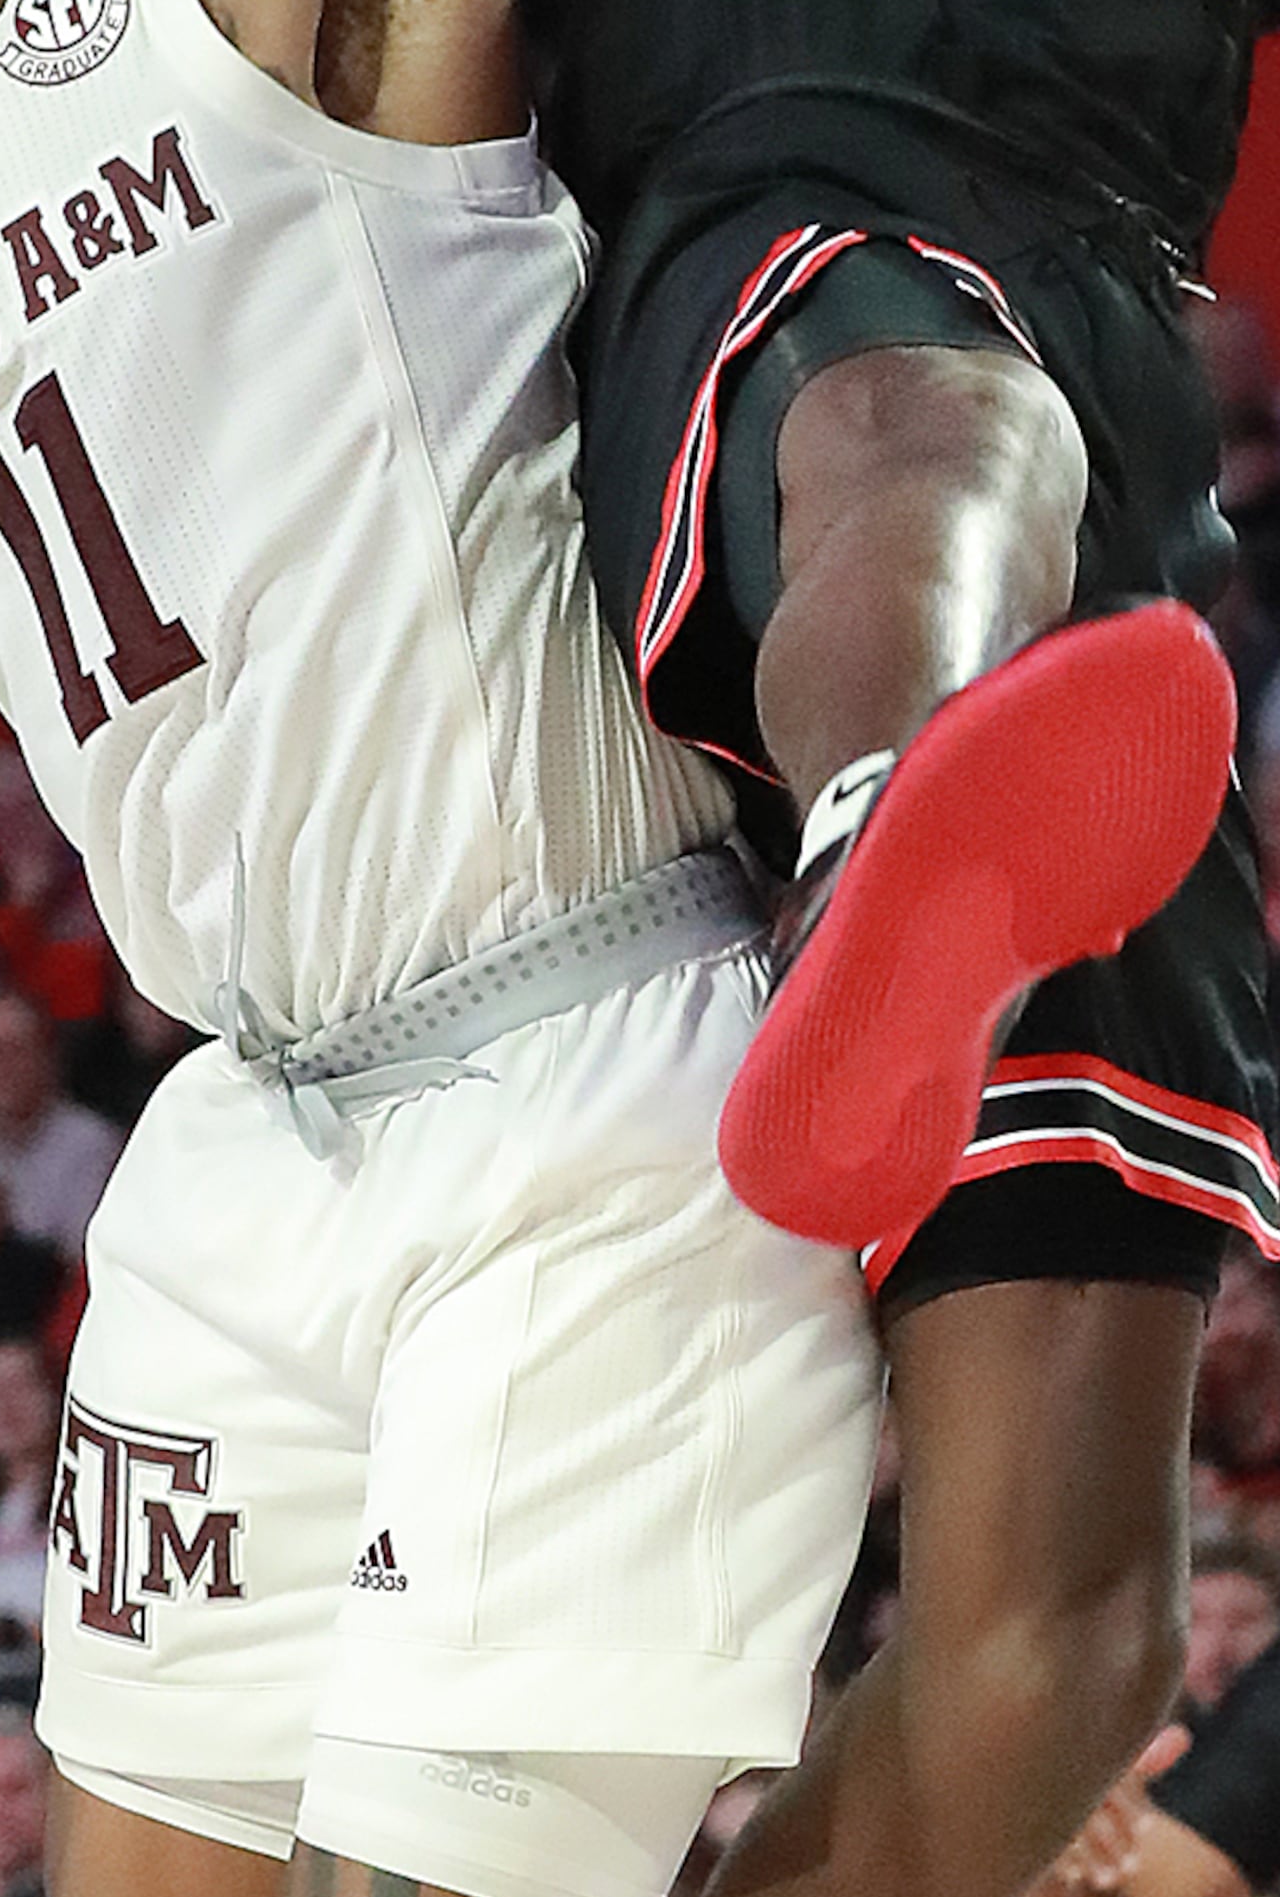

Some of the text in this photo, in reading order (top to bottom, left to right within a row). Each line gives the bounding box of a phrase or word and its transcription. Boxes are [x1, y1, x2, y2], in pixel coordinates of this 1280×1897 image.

[18, 12, 122, 82] GRADUATE
[1, 126, 217, 323] A&M
[421, 1757, 533, 1808] adidas
